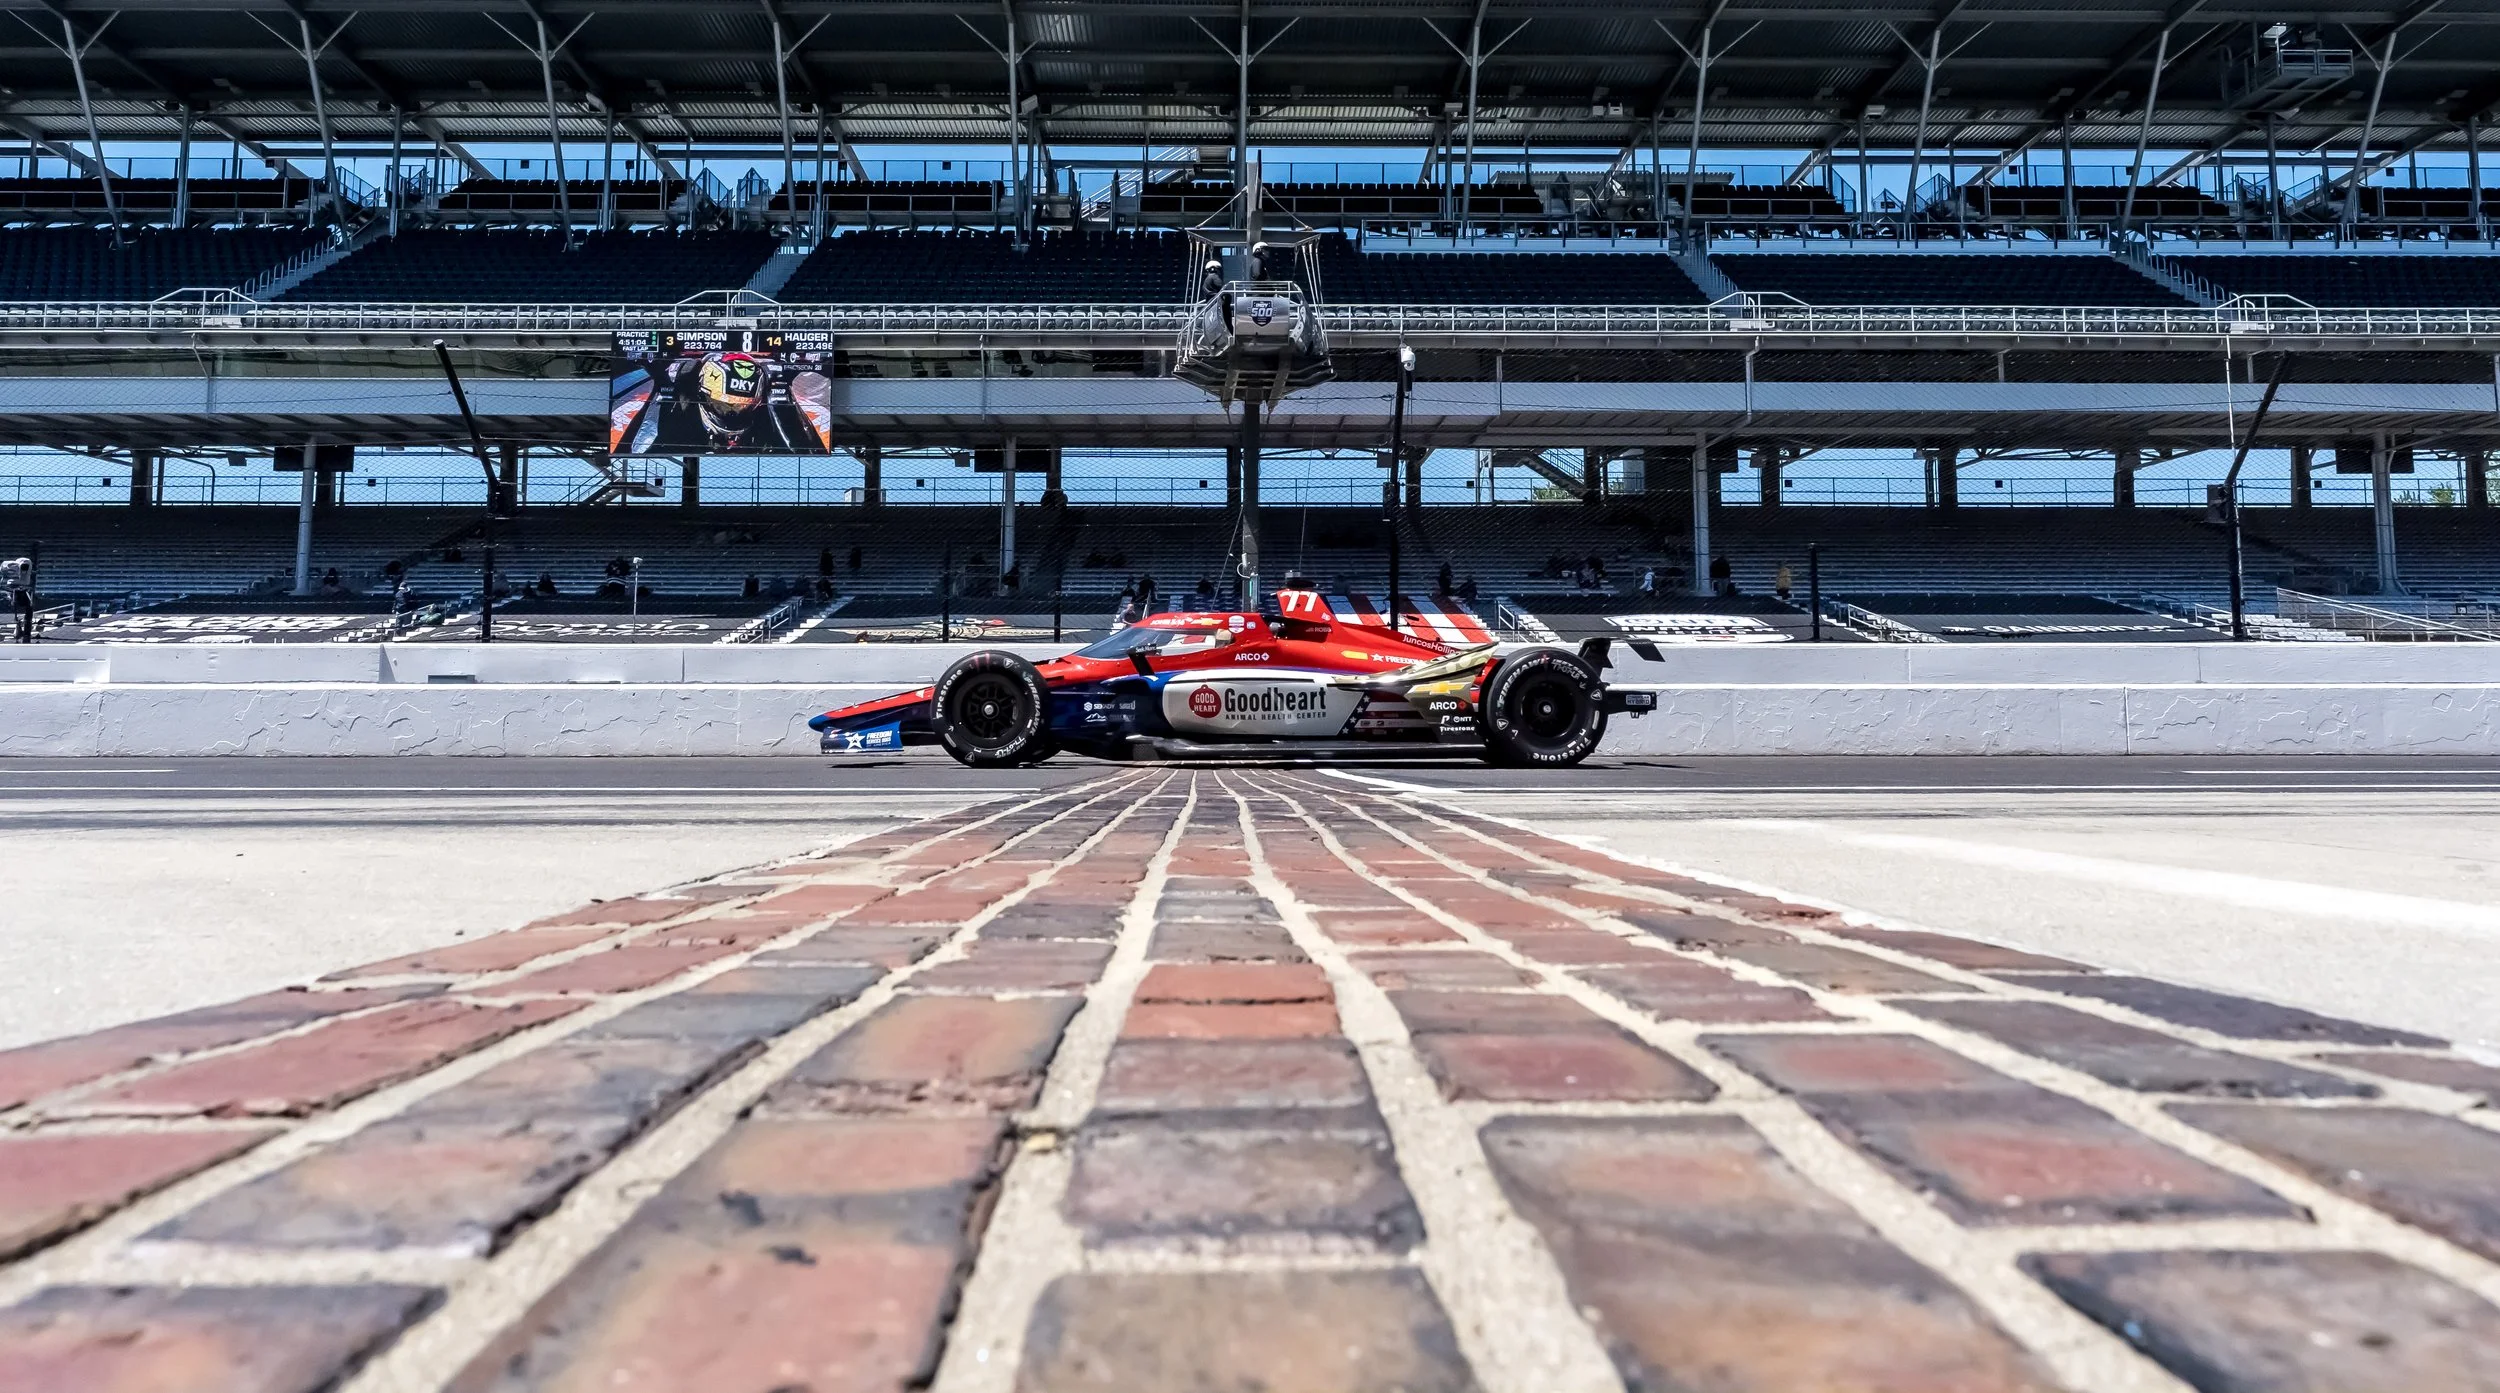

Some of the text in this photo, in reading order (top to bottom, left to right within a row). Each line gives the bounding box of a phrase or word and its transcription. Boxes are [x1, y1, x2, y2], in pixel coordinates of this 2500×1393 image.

[1251, 308, 1273, 317] 500
[666, 336, 674, 346] 3
[676, 332, 727, 341] SIMPSON
[766, 336, 782, 347] 14
[784, 332, 829, 342] HAUGER
[684, 341, 722, 350] 223.764
[742, 331, 753, 353] 8
[730, 378, 755, 391] DKY
[1280, 590, 1318, 612] 77
[1235, 653, 1261, 661] ARCO
[934, 669, 963, 720] Firestone
[1195, 692, 1215, 704] GOOD
[1224, 687, 1327, 713] Goodheart
[1023, 675, 1041, 736] FIREHAWK
[1193, 705, 1217, 713] HEART
[1429, 701, 1457, 710] ARCO
[1296, 711, 1327, 719] CENTER
[1533, 737, 1592, 761] Firestone
